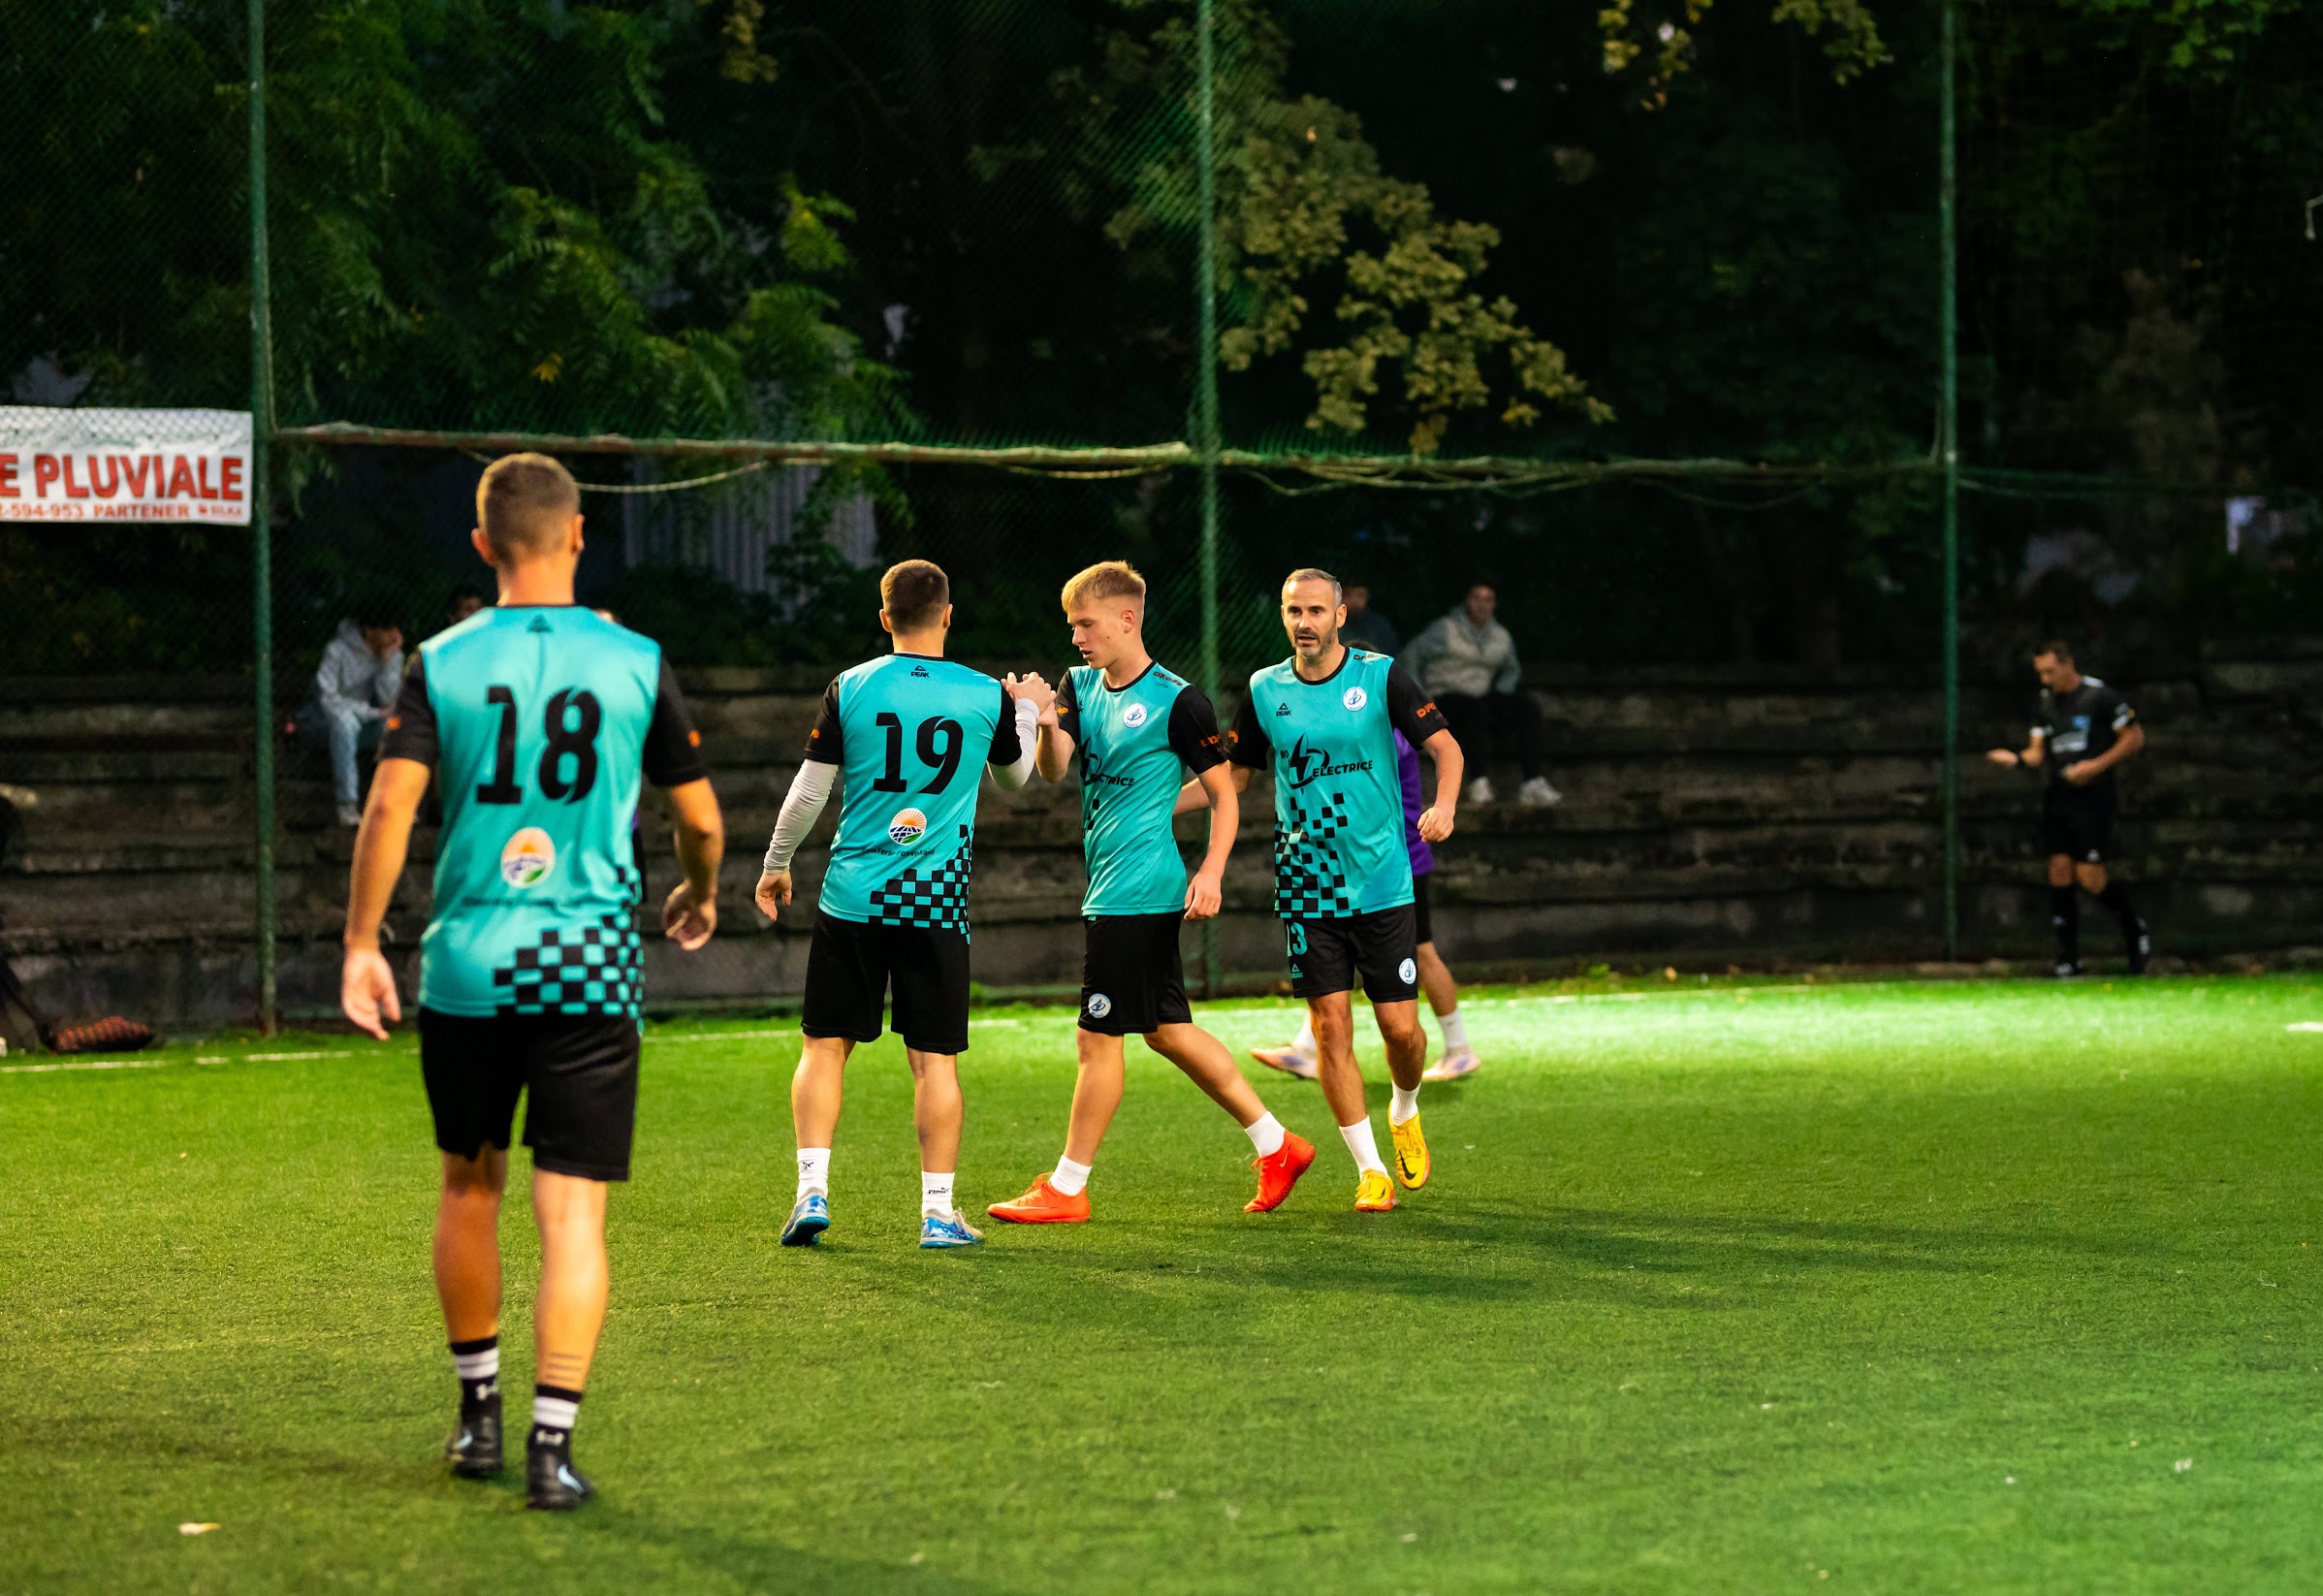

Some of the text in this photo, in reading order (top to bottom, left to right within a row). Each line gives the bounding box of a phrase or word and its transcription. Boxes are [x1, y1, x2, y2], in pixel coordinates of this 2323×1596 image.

[0, 454, 242, 500] E PLUVIALE
[0, 503, 83, 517] -594-953
[93, 504, 190, 519] PARTENER
[476, 686, 602, 796] 18
[873, 712, 964, 795] 19
[1313, 760, 1373, 777] ELECTRICE
